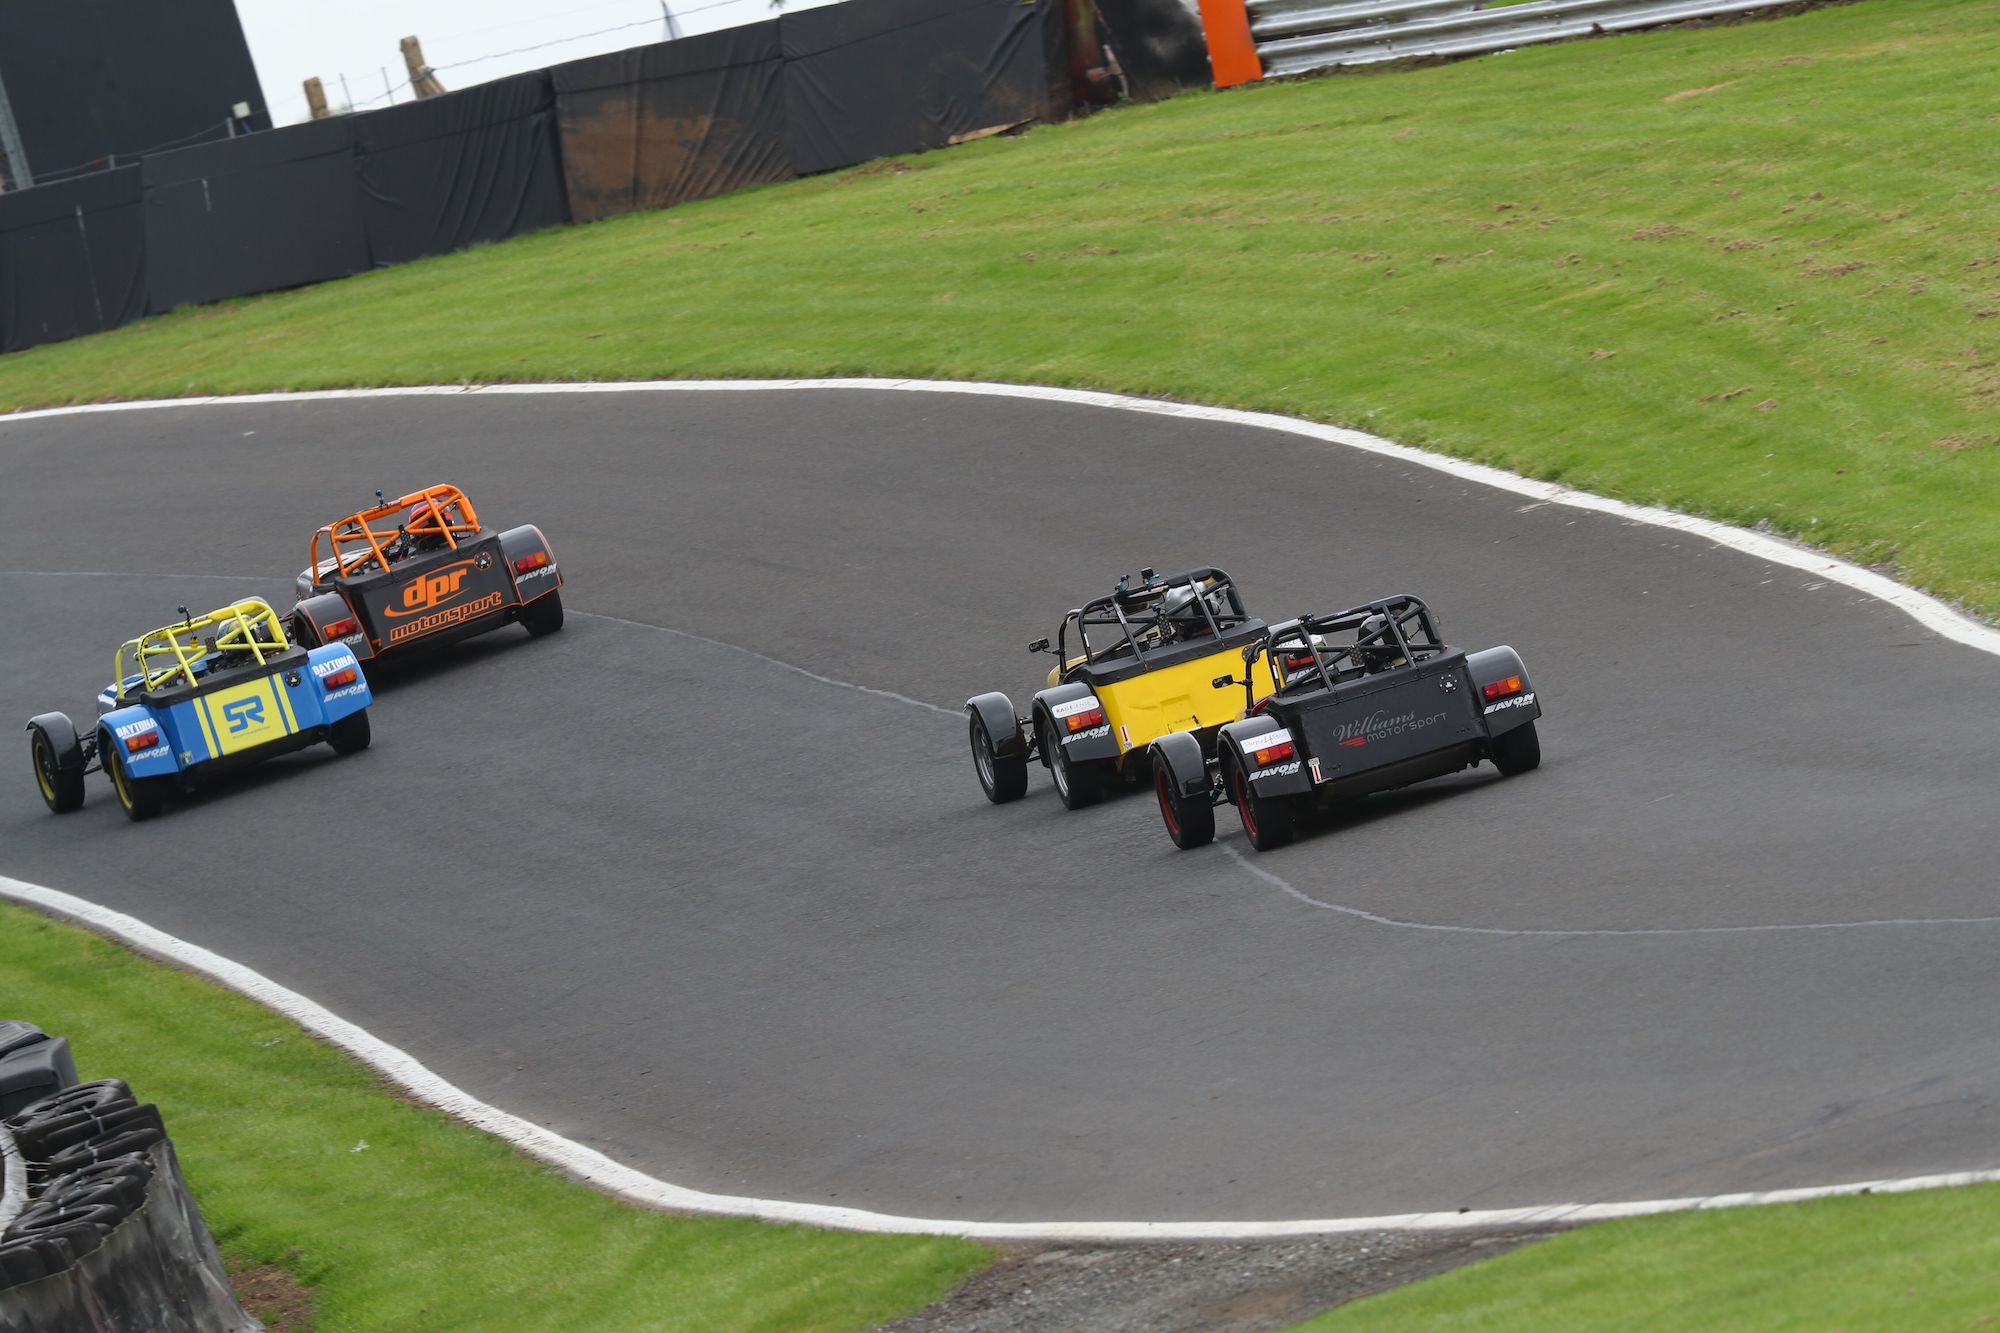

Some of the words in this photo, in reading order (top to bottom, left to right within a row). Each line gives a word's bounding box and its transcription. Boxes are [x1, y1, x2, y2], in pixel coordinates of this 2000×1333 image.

[525, 563, 557, 581] AVON
[403, 567, 467, 607] dpr
[390, 591, 502, 641] motorsport
[312, 654, 356, 676] DAYTONA
[333, 682, 367, 700] AVON
[1494, 692, 1535, 711] AVON
[115, 717, 158, 738] DAYTONA
[1071, 724, 1110, 742] AVON
[1333, 710, 1415, 742] Williams
[136, 745, 170, 761] AVON
[1259, 761, 1301, 778] AVON
